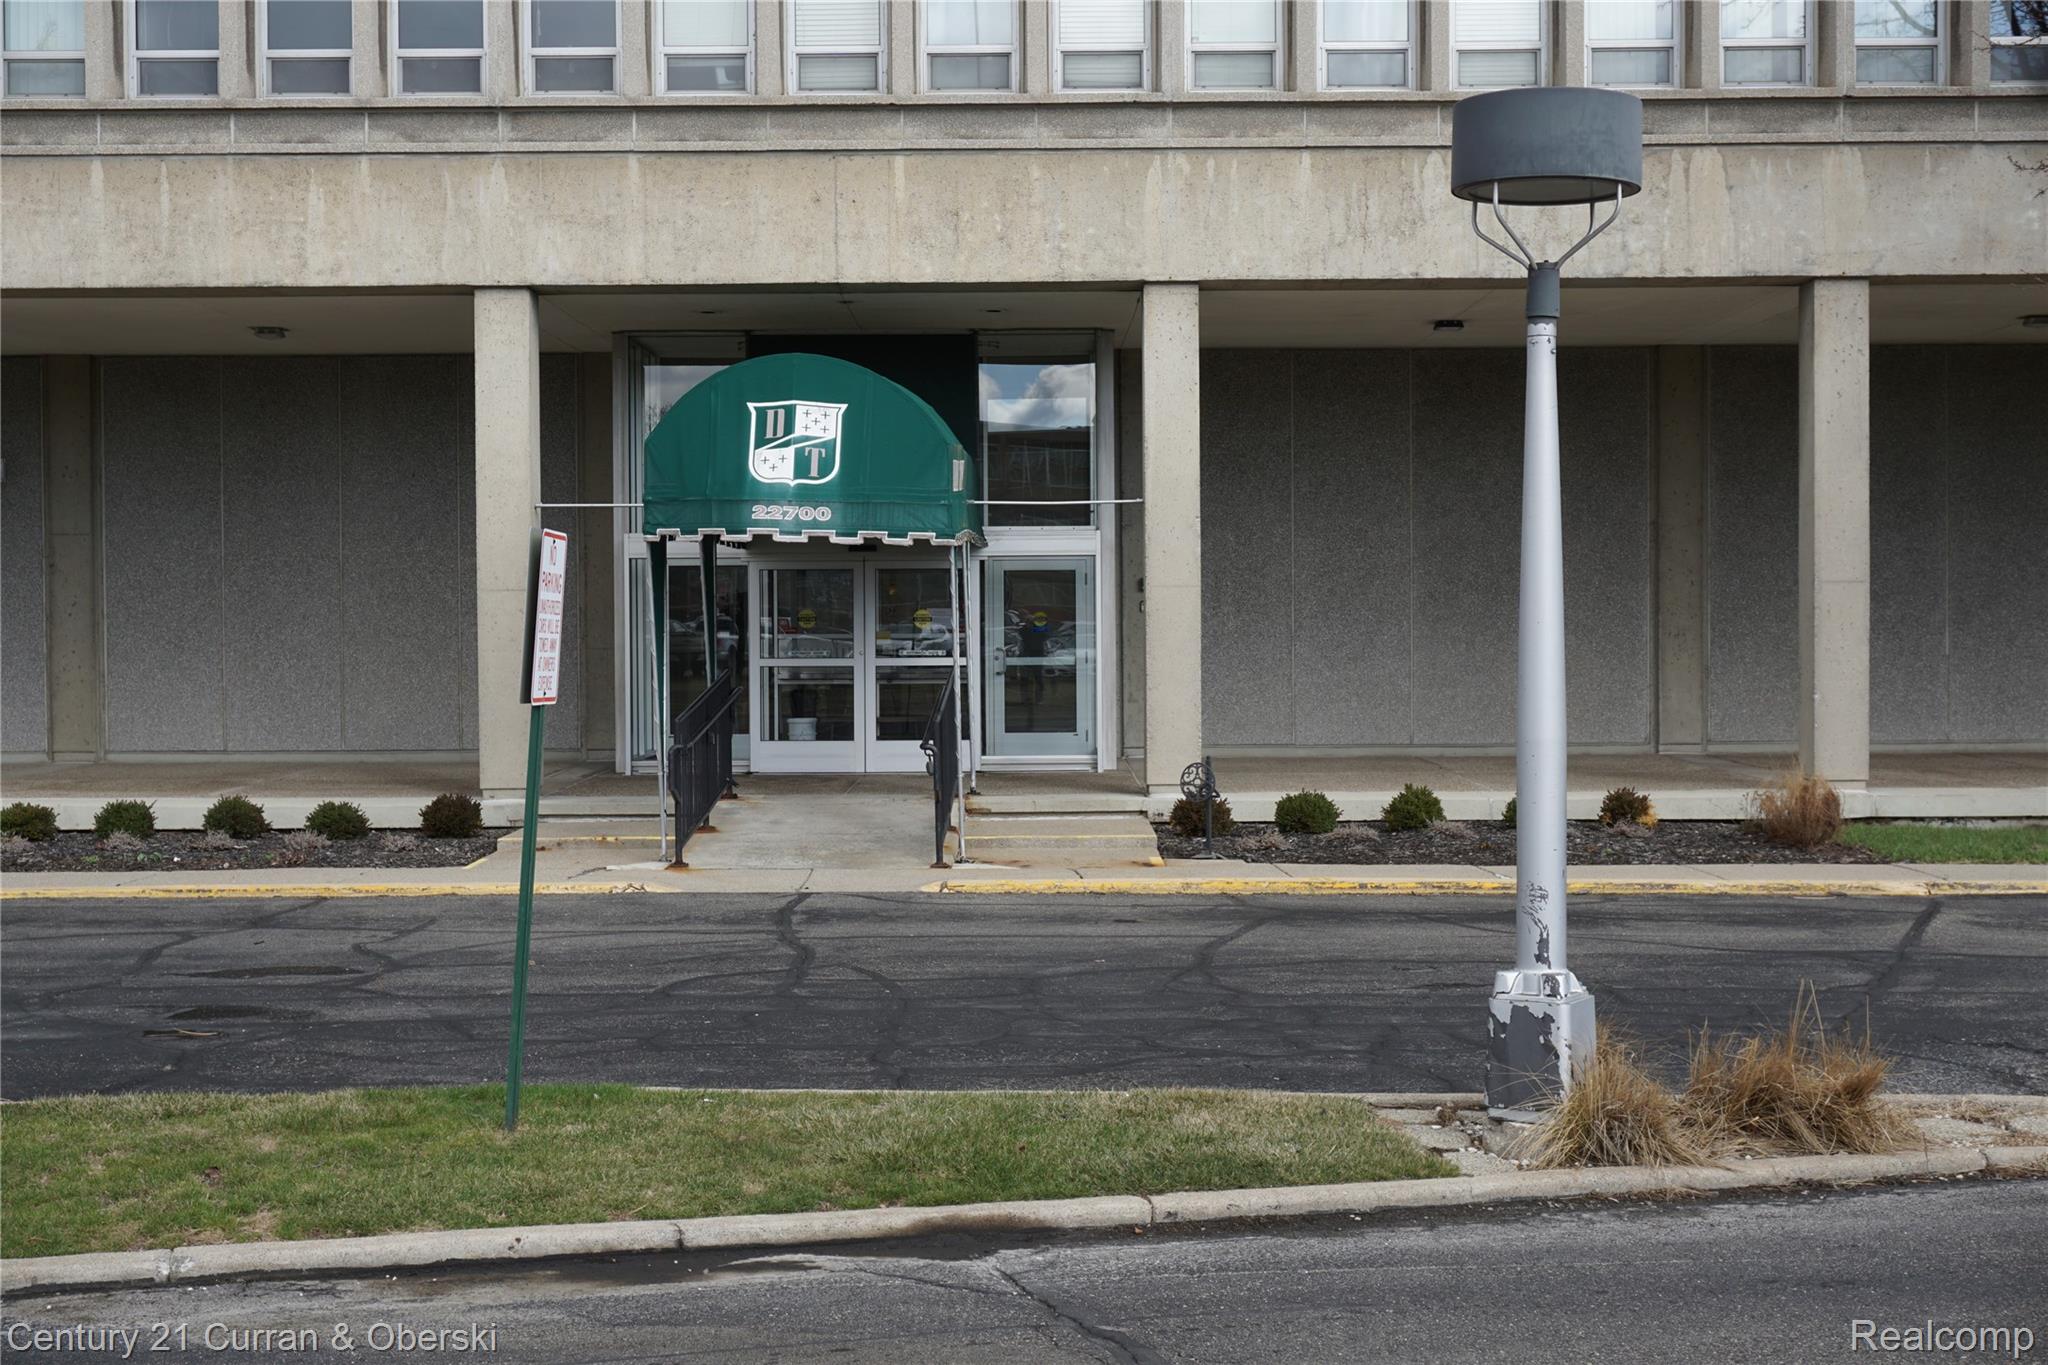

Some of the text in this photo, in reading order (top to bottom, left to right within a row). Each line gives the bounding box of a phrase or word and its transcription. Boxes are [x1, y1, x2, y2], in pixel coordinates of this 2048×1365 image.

[805, 446, 826, 478] T
[752, 504, 832, 524] 22700
[541, 571, 563, 595] PARKING
